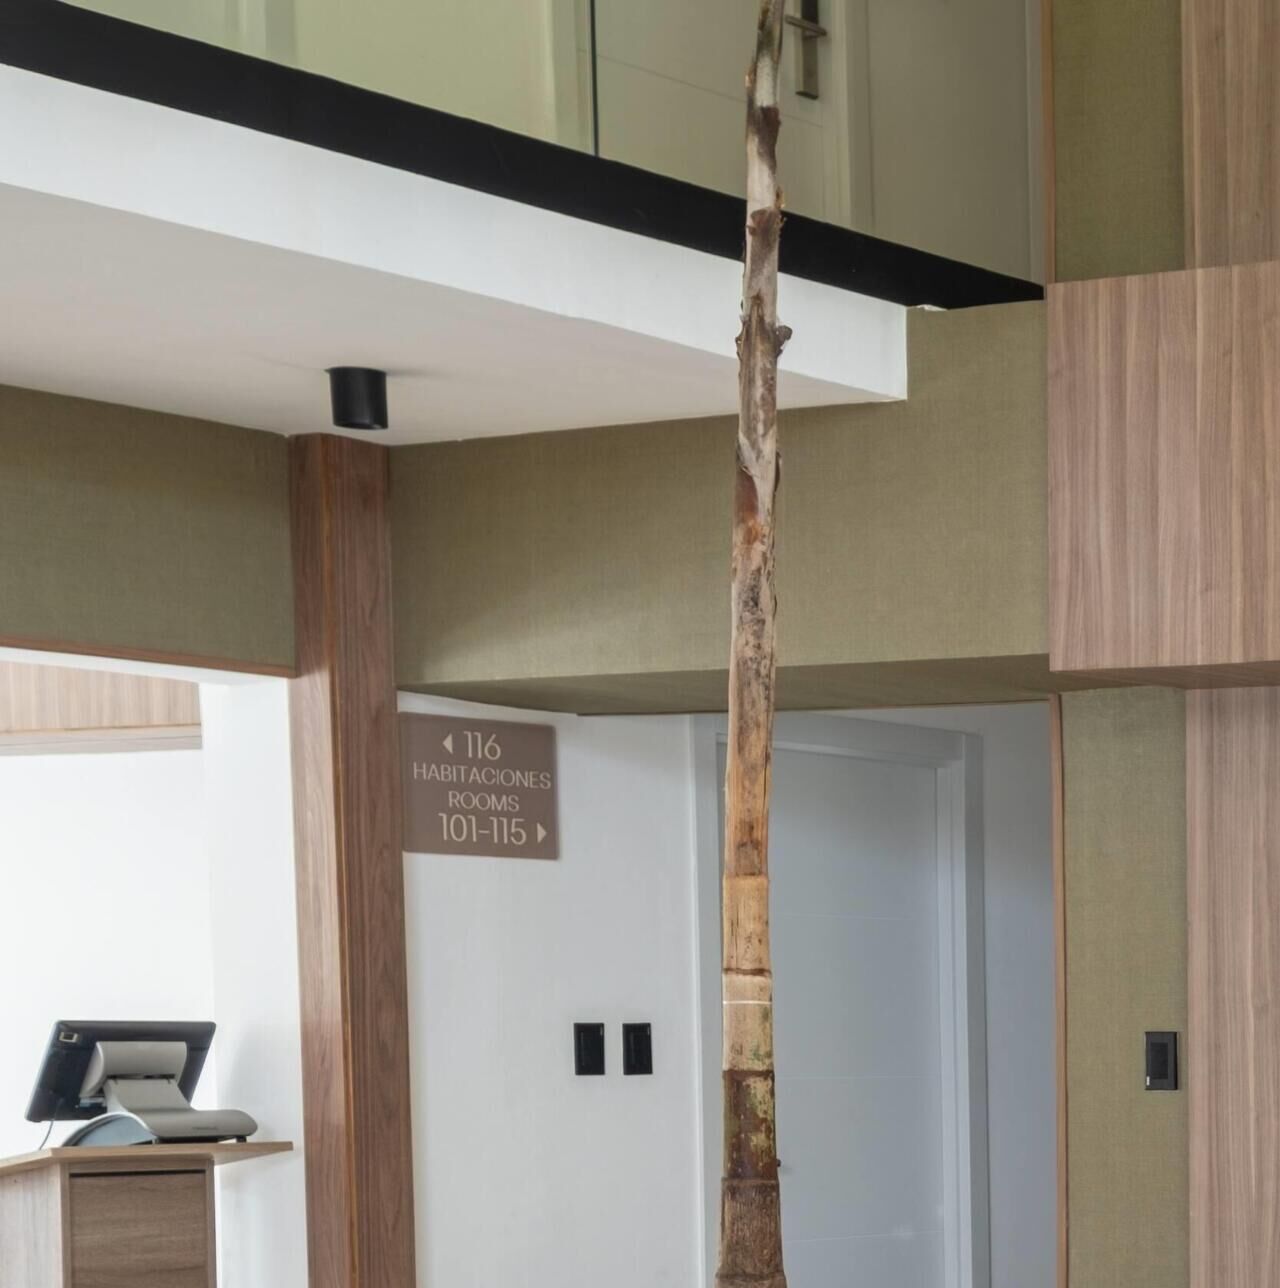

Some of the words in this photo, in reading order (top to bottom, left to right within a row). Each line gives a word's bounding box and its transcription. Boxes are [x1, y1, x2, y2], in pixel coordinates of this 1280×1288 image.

[463, 730, 501, 760] 116
[412, 761, 552, 789] HABITACIONES
[447, 790, 520, 812] ROOMS
[437, 812, 527, 845] 101-115
